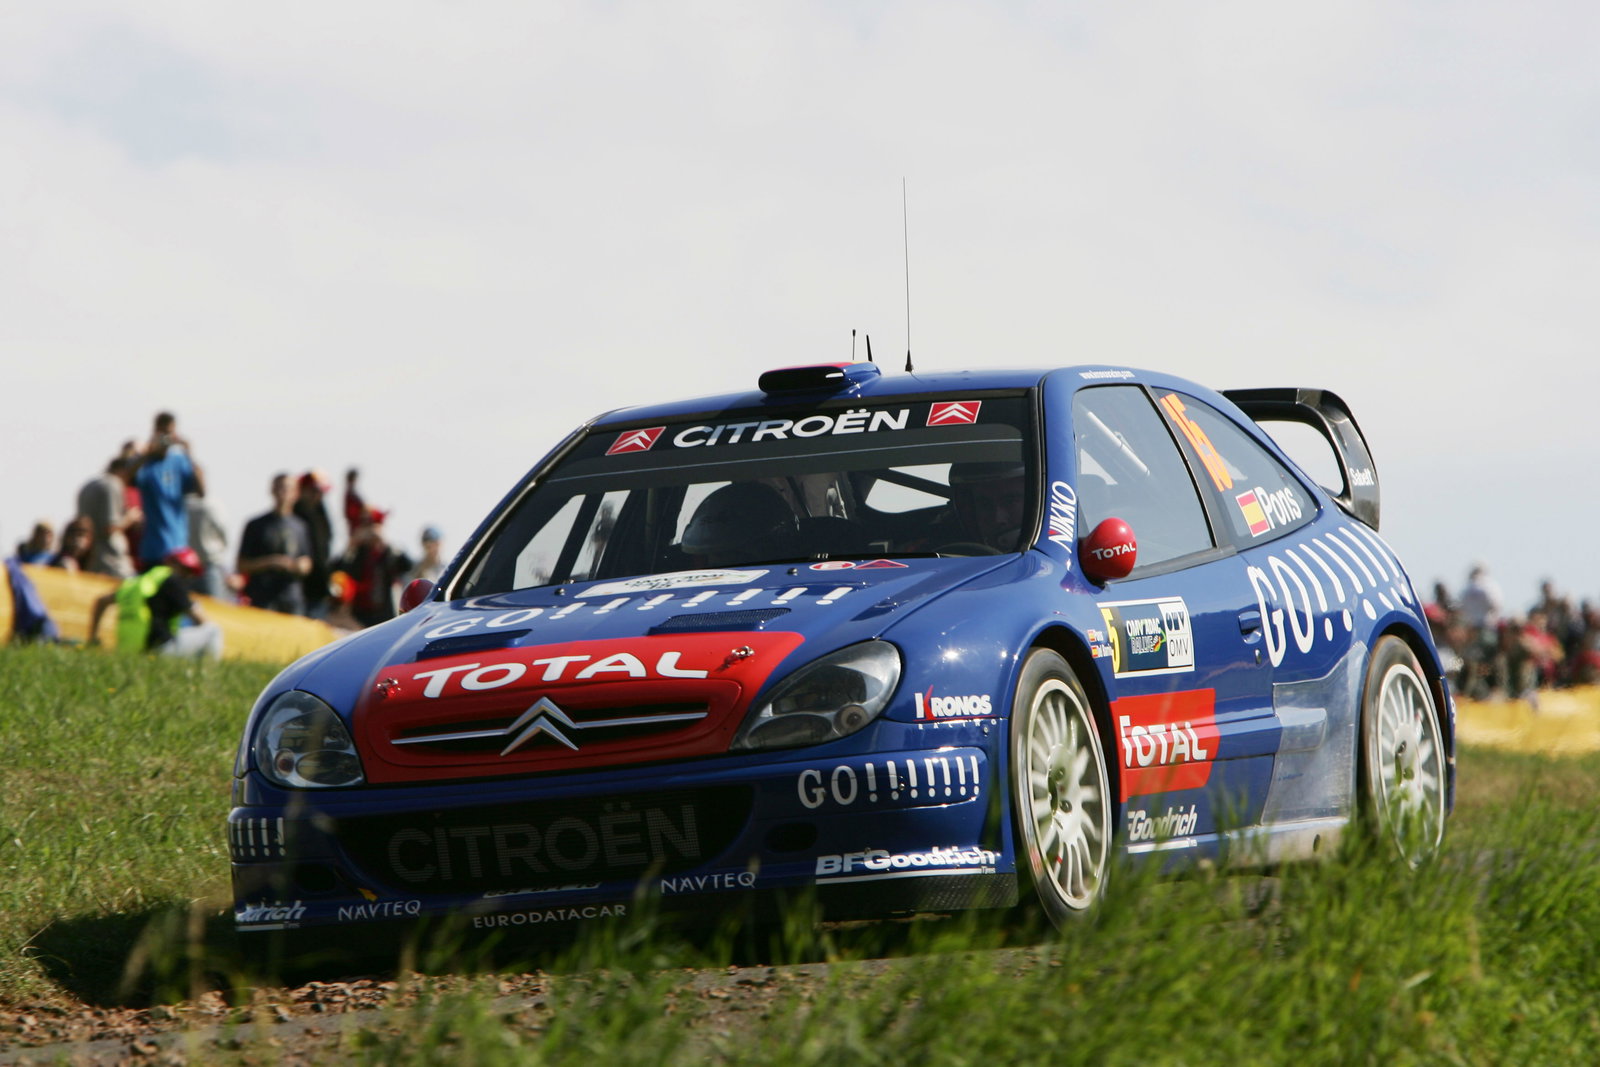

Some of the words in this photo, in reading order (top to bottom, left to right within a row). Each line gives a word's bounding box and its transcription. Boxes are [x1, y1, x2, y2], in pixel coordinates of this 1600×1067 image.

[673, 409, 910, 448] CITROËN
[1047, 481, 1077, 553] NIKKO
[1254, 486, 1302, 529] Pons
[1092, 542, 1136, 560] TOTAL
[1168, 639, 1189, 657] OMV
[412, 651, 710, 699] TOTAL
[914, 684, 993, 720] KRONOS
[1119, 715, 1207, 768] TOTAL
[387, 801, 702, 883] CITROËN
[816, 847, 996, 876] BFGoodrich
[660, 871, 757, 894] NAVTEQ
[337, 899, 421, 921] NAVTEQ
[473, 904, 627, 928] EURODATACAR
